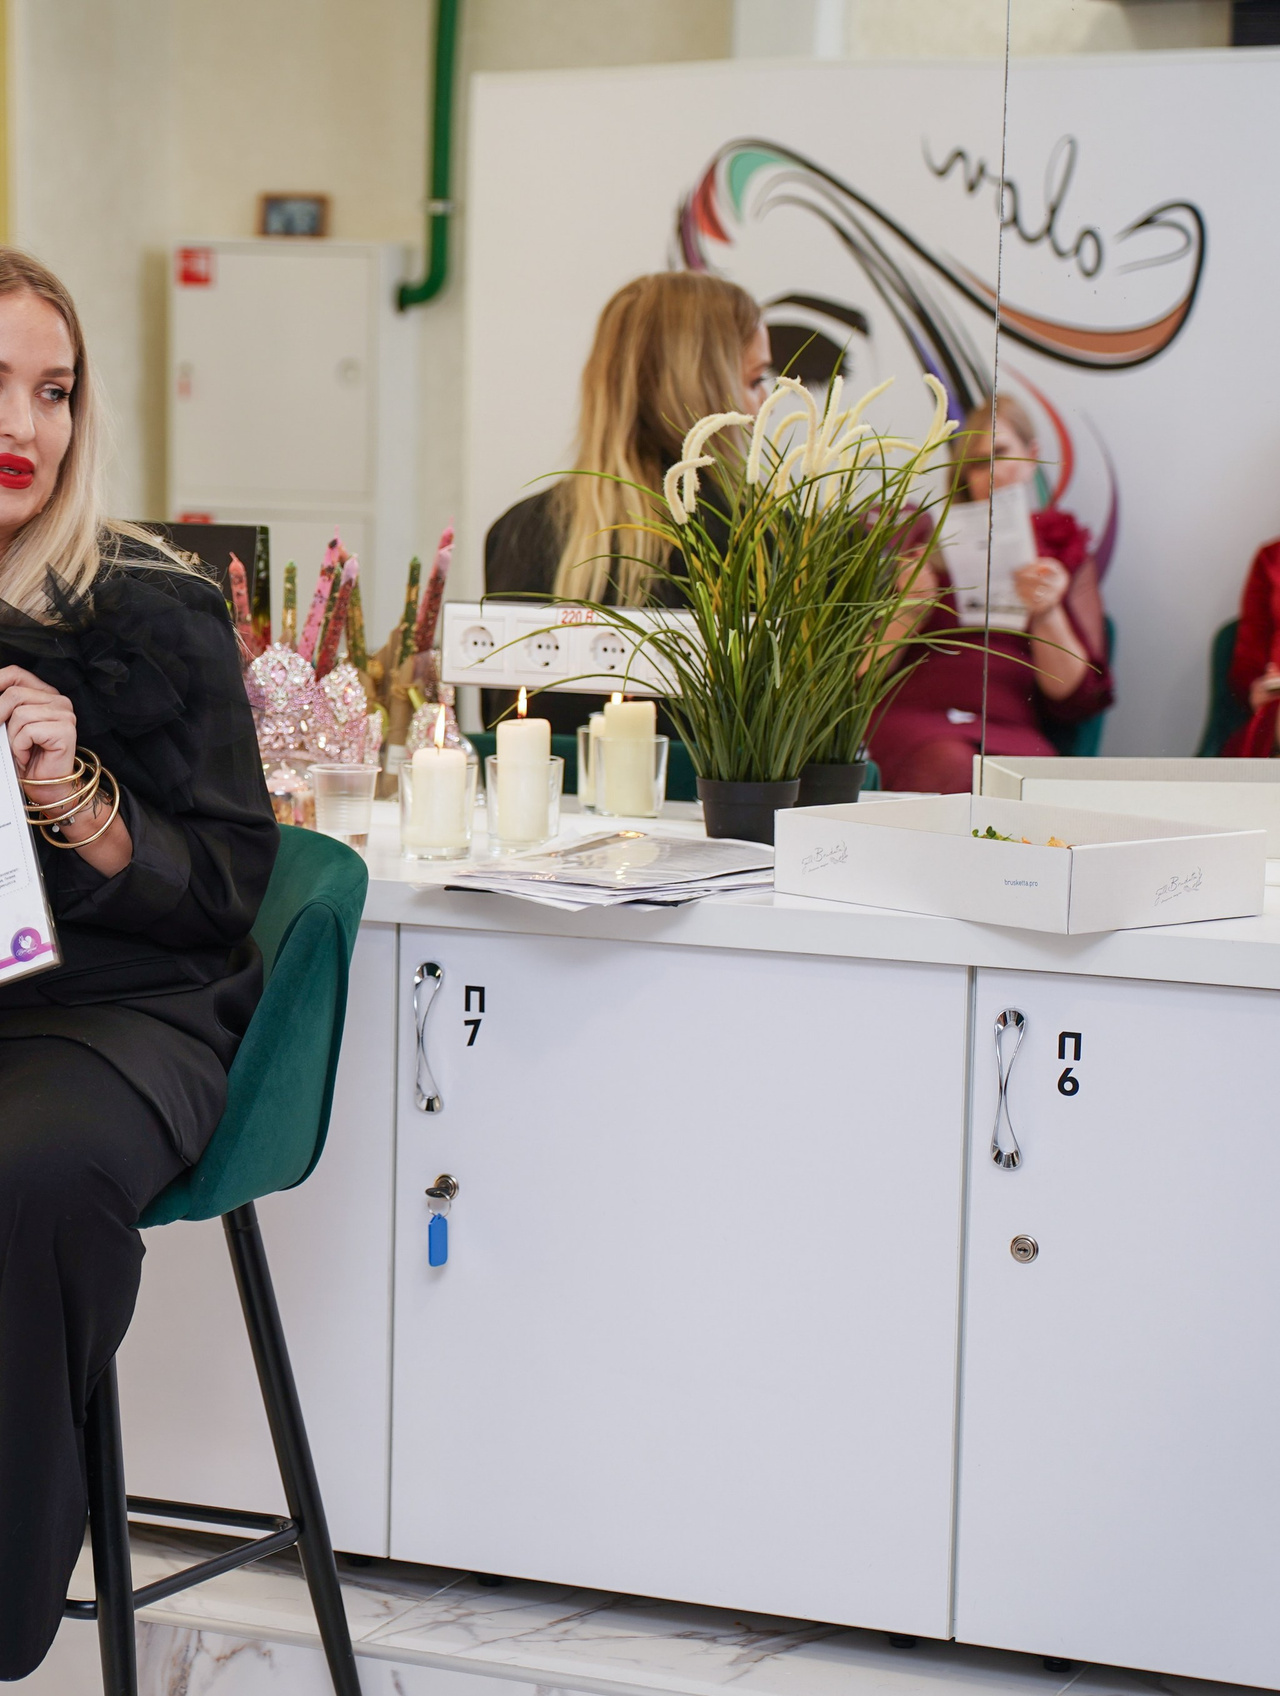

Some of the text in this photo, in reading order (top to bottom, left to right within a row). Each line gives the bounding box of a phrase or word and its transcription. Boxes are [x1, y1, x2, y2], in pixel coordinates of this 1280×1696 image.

[464, 985, 486, 1013] П
[464, 1018, 483, 1047] 7
[1058, 1031, 1082, 1061] П
[1057, 1067, 1080, 1096] 6
